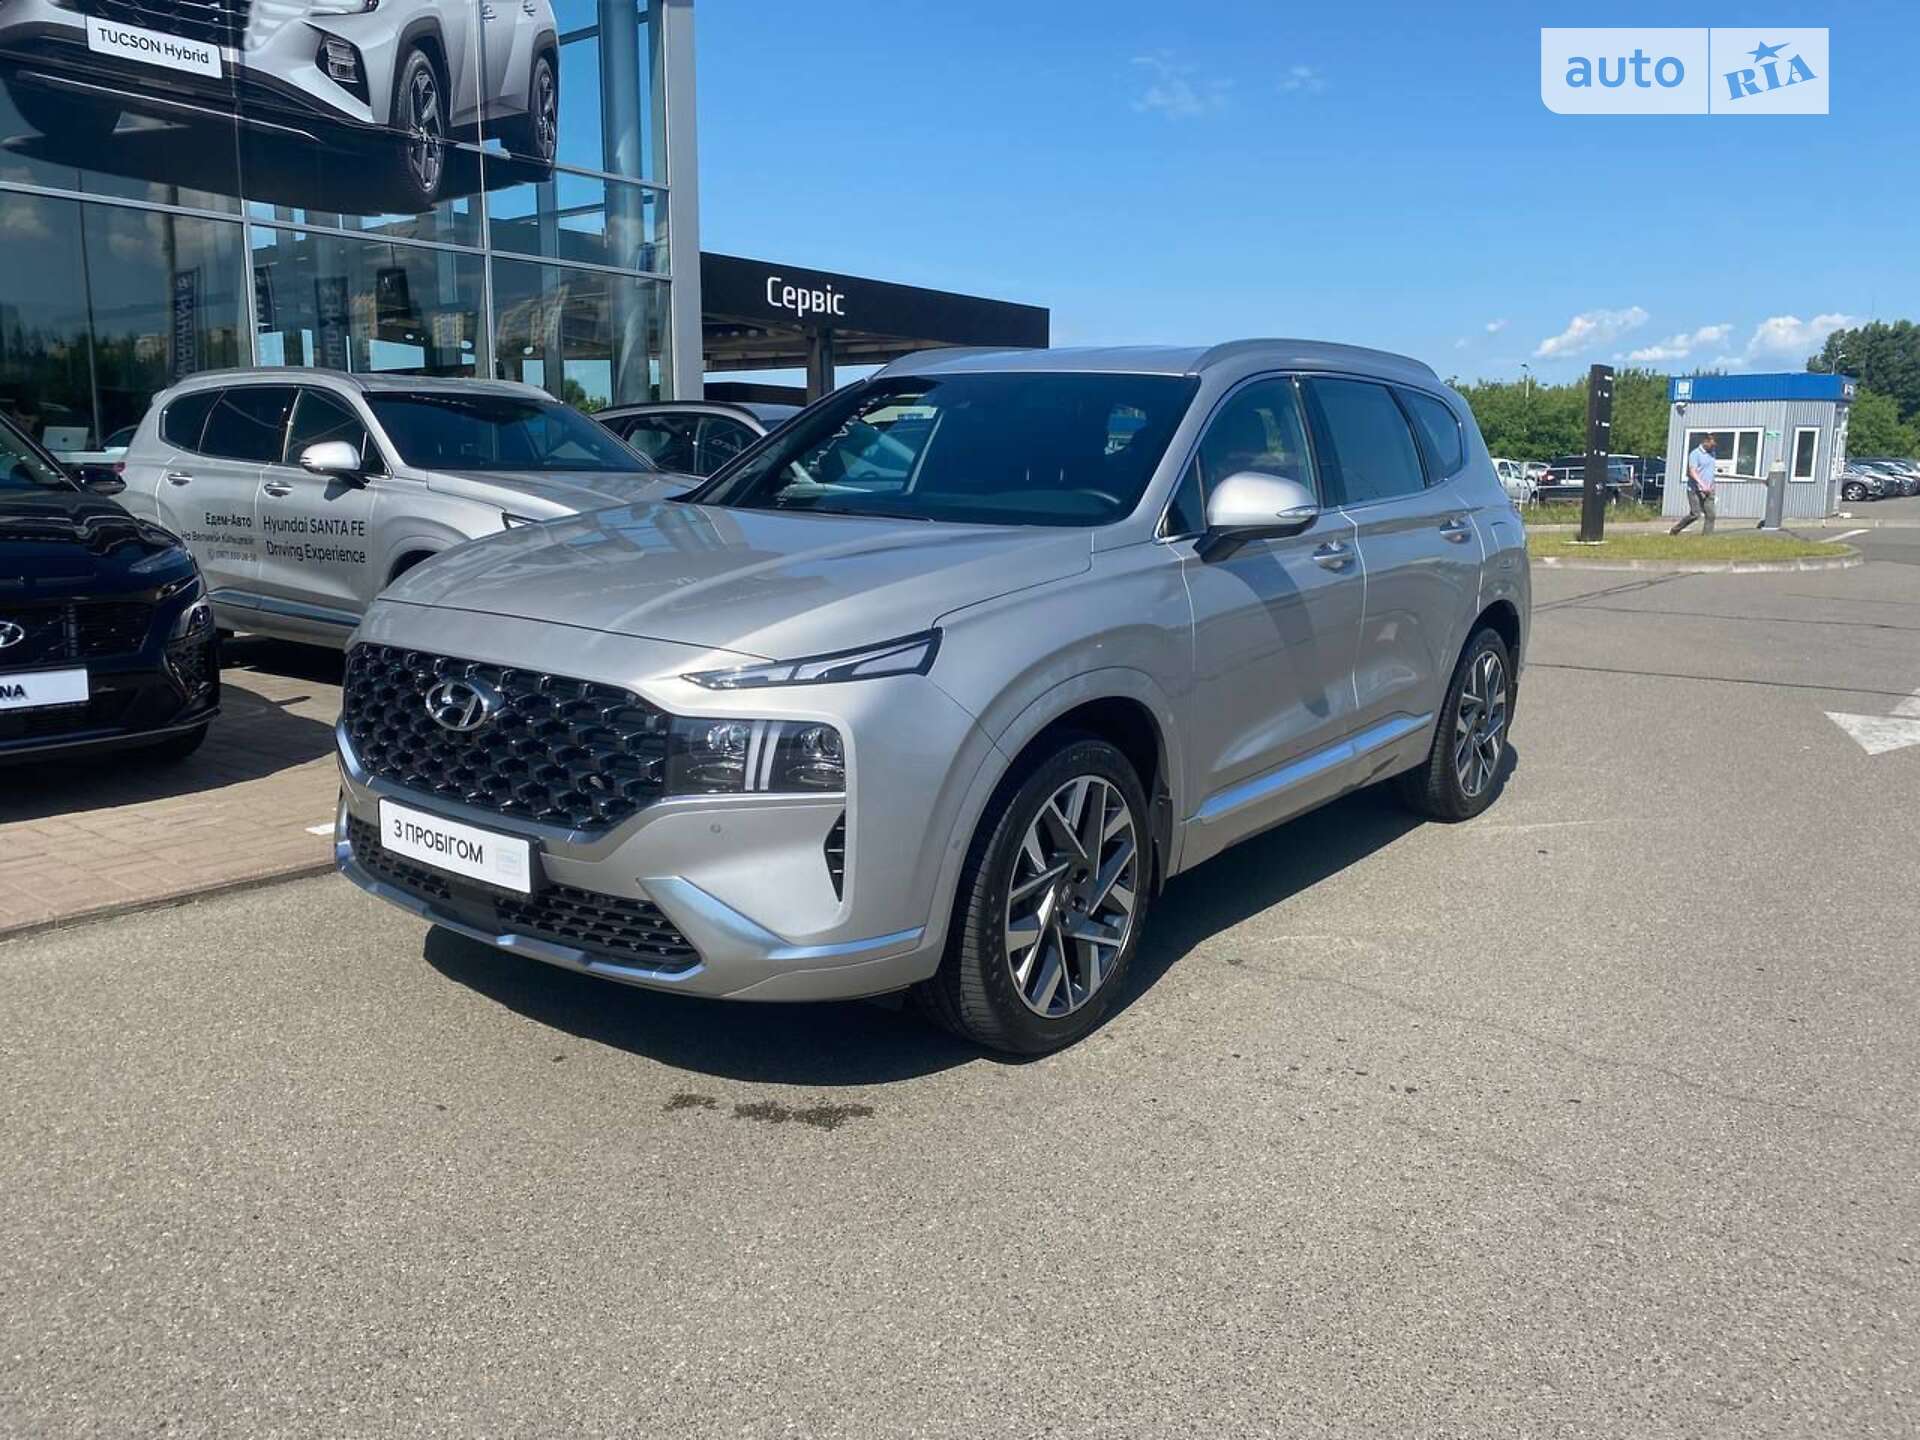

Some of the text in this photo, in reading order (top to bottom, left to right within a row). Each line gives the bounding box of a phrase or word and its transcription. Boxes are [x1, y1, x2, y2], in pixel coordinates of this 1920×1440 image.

[98, 28, 209, 64] TUCSON Hybrid
[767, 276, 845, 318] Сервіс
[205, 512, 252, 528] Едем-Авто
[263, 515, 365, 536] Hyundai SANTA FE
[266, 540, 304, 562] Driving
[304, 543, 366, 563] Experience
[405, 823, 483, 865] ПРОБІГОМ
